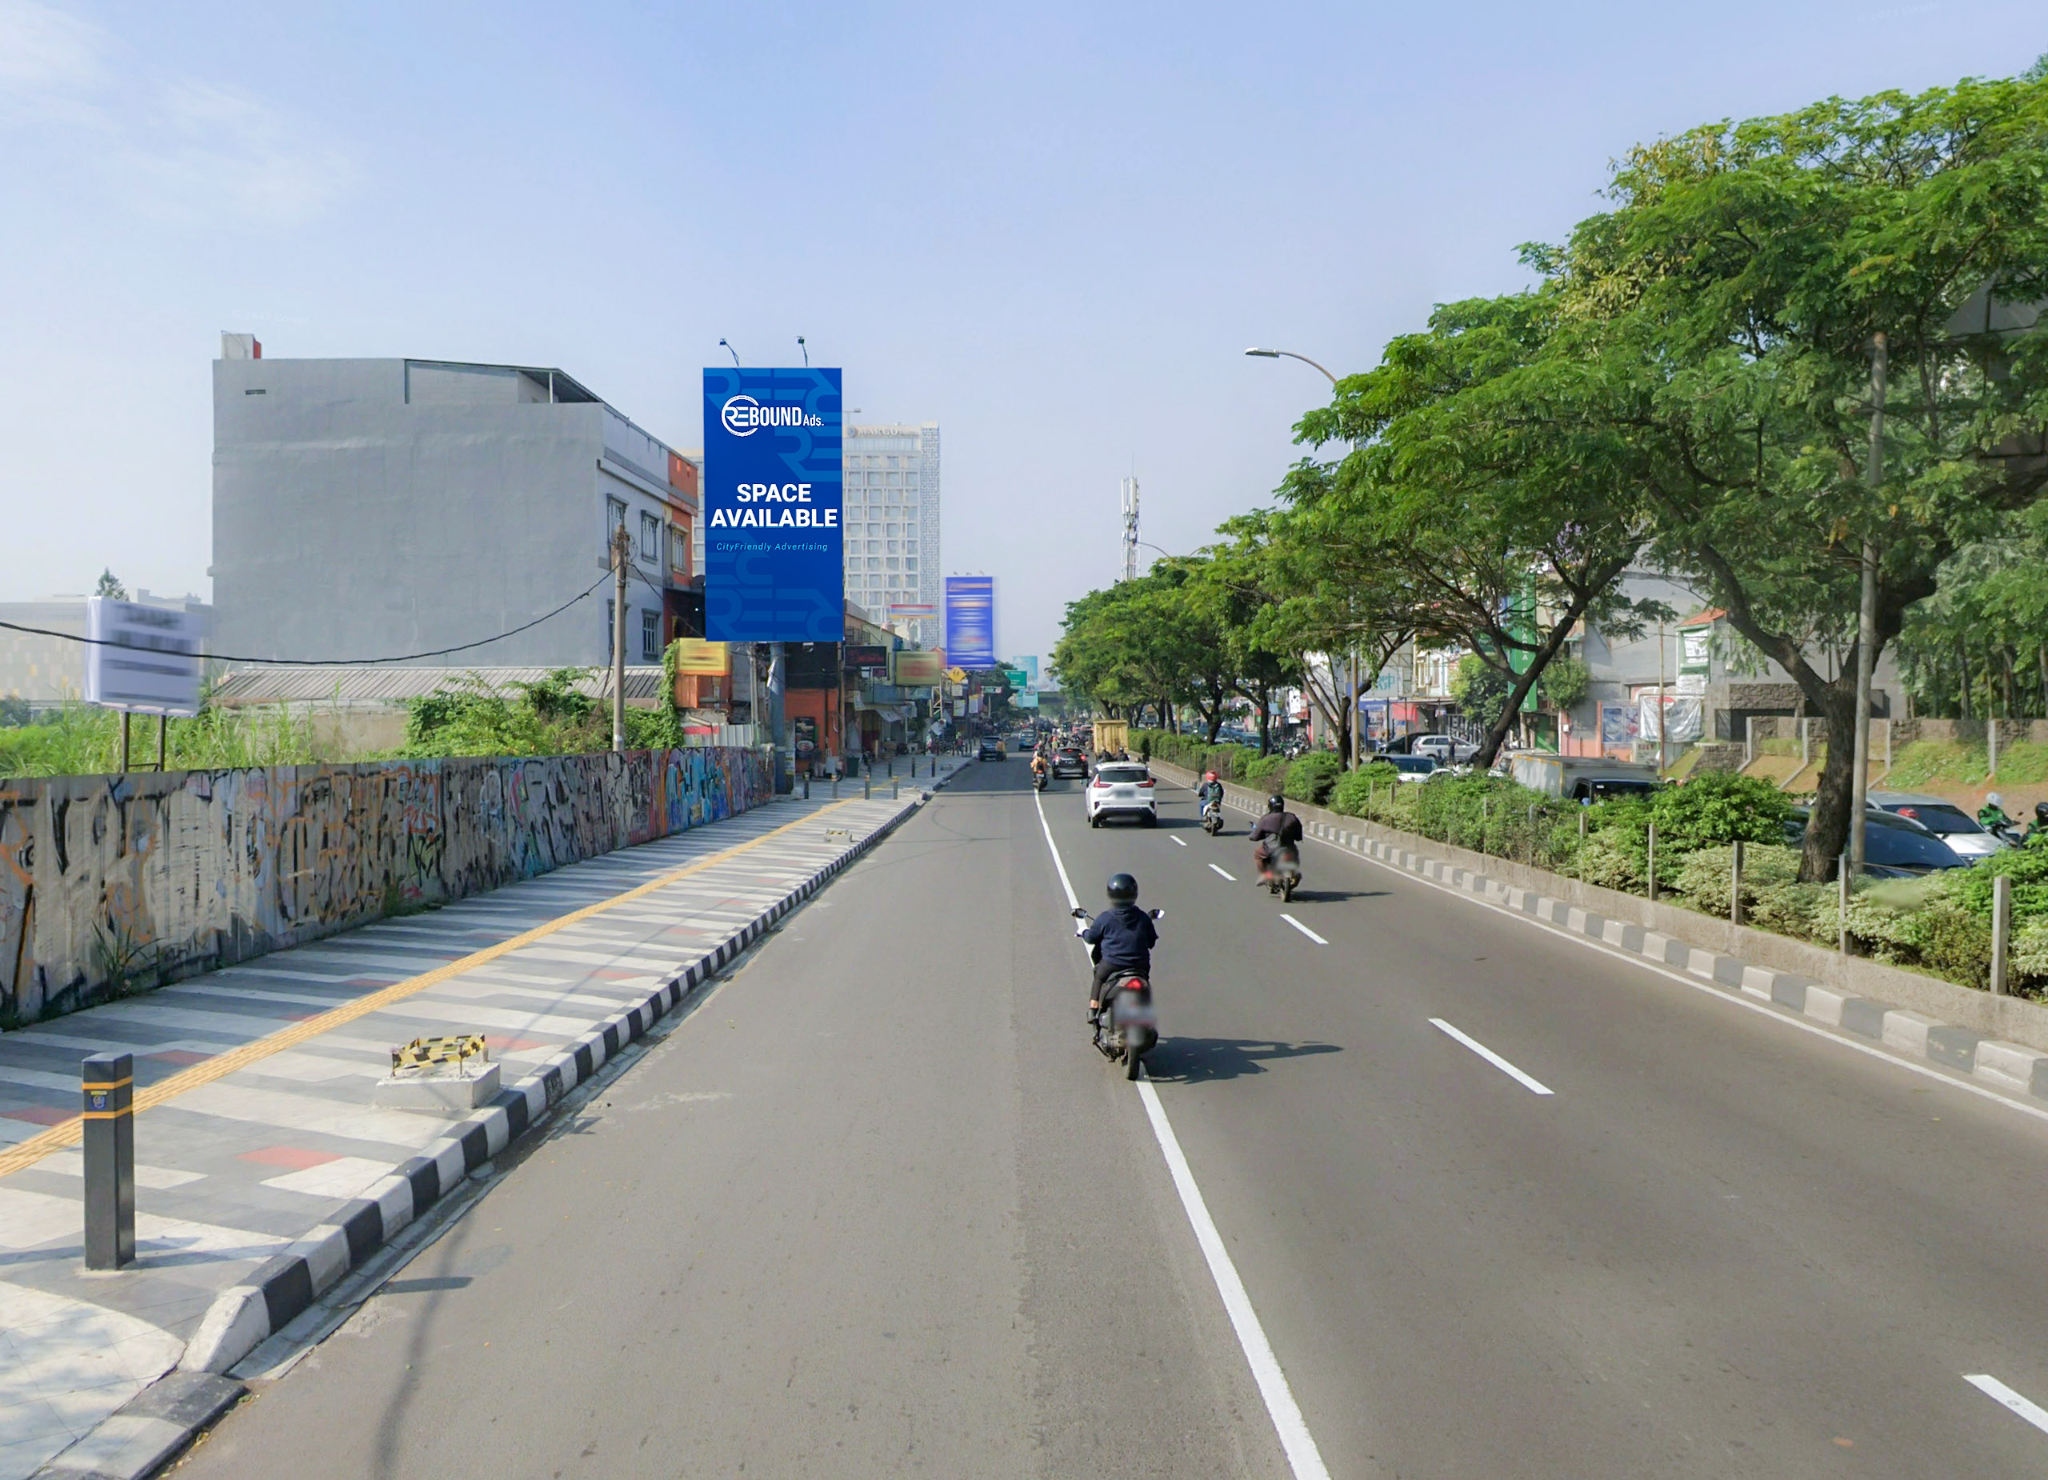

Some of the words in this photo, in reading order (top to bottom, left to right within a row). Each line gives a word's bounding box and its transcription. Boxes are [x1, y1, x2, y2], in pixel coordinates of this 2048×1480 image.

[724, 406, 802, 427] REBOUND
[803, 414, 825, 427] Ads.
[736, 483, 812, 503] SPACE
[710, 508, 838, 528] AVAILABLE
[716, 542, 772, 553] CityFriendly
[774, 542, 828, 553] Advertising
